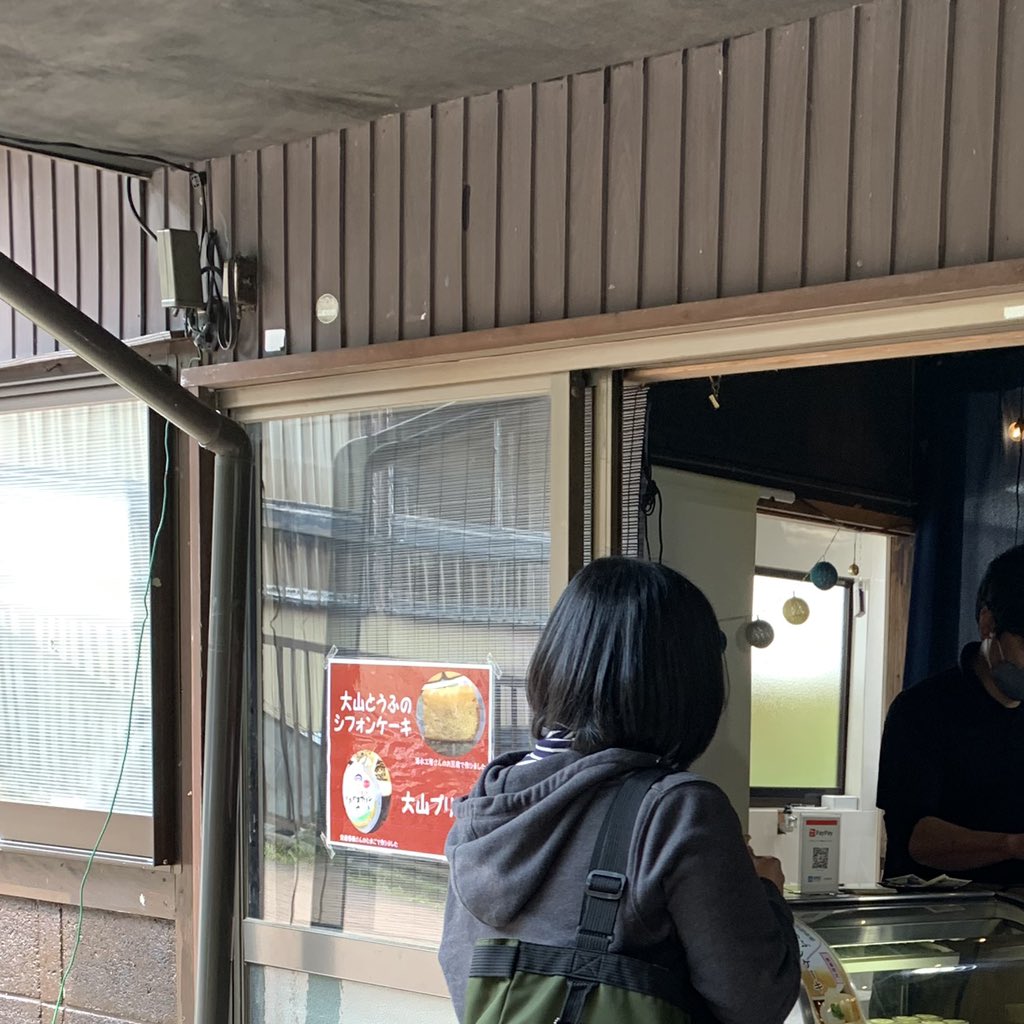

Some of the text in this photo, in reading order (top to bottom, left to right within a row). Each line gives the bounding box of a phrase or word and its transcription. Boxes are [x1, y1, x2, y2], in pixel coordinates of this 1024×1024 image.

[339, 690, 413, 714] 大山とうふの
[334, 714, 412, 737] シフォンケーキ
